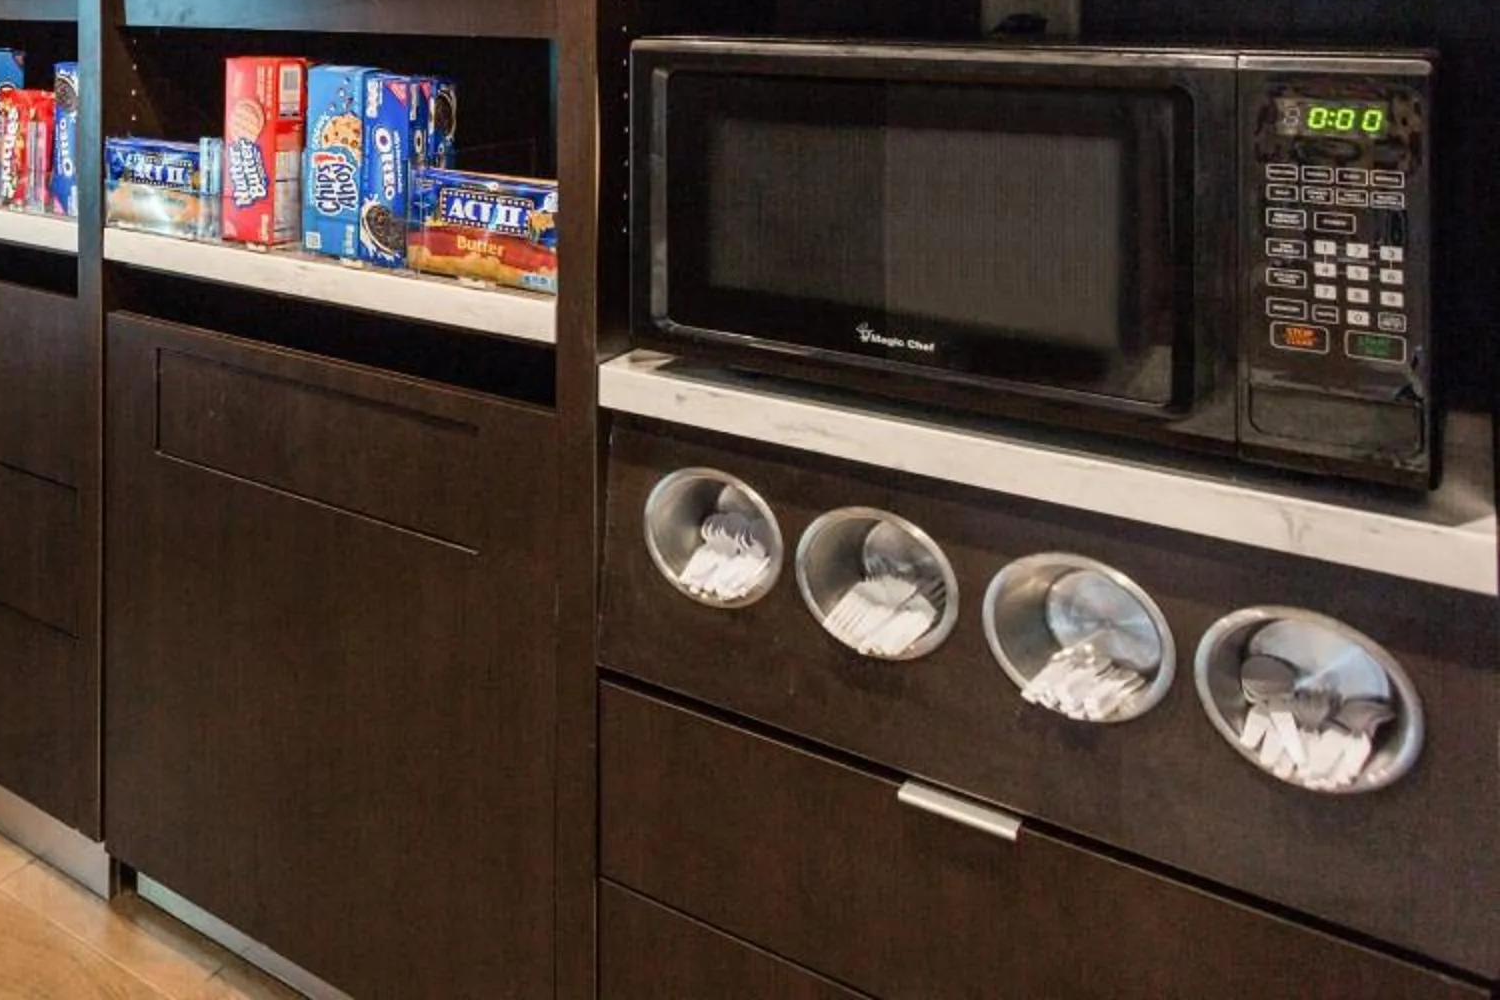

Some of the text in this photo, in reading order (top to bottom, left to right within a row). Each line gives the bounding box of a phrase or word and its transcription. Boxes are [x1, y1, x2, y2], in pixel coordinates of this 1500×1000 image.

[1308, 107, 1383, 132] 0:00
[230, 146, 252, 207] Nutter
[238, 137, 267, 199] Butter
[373, 127, 396, 201] OREO
[315, 162, 340, 214] Chips
[449, 197, 524, 227] ACT II
[456, 235, 506, 257] Butter
[871, 333, 935, 353] Magic Chef
